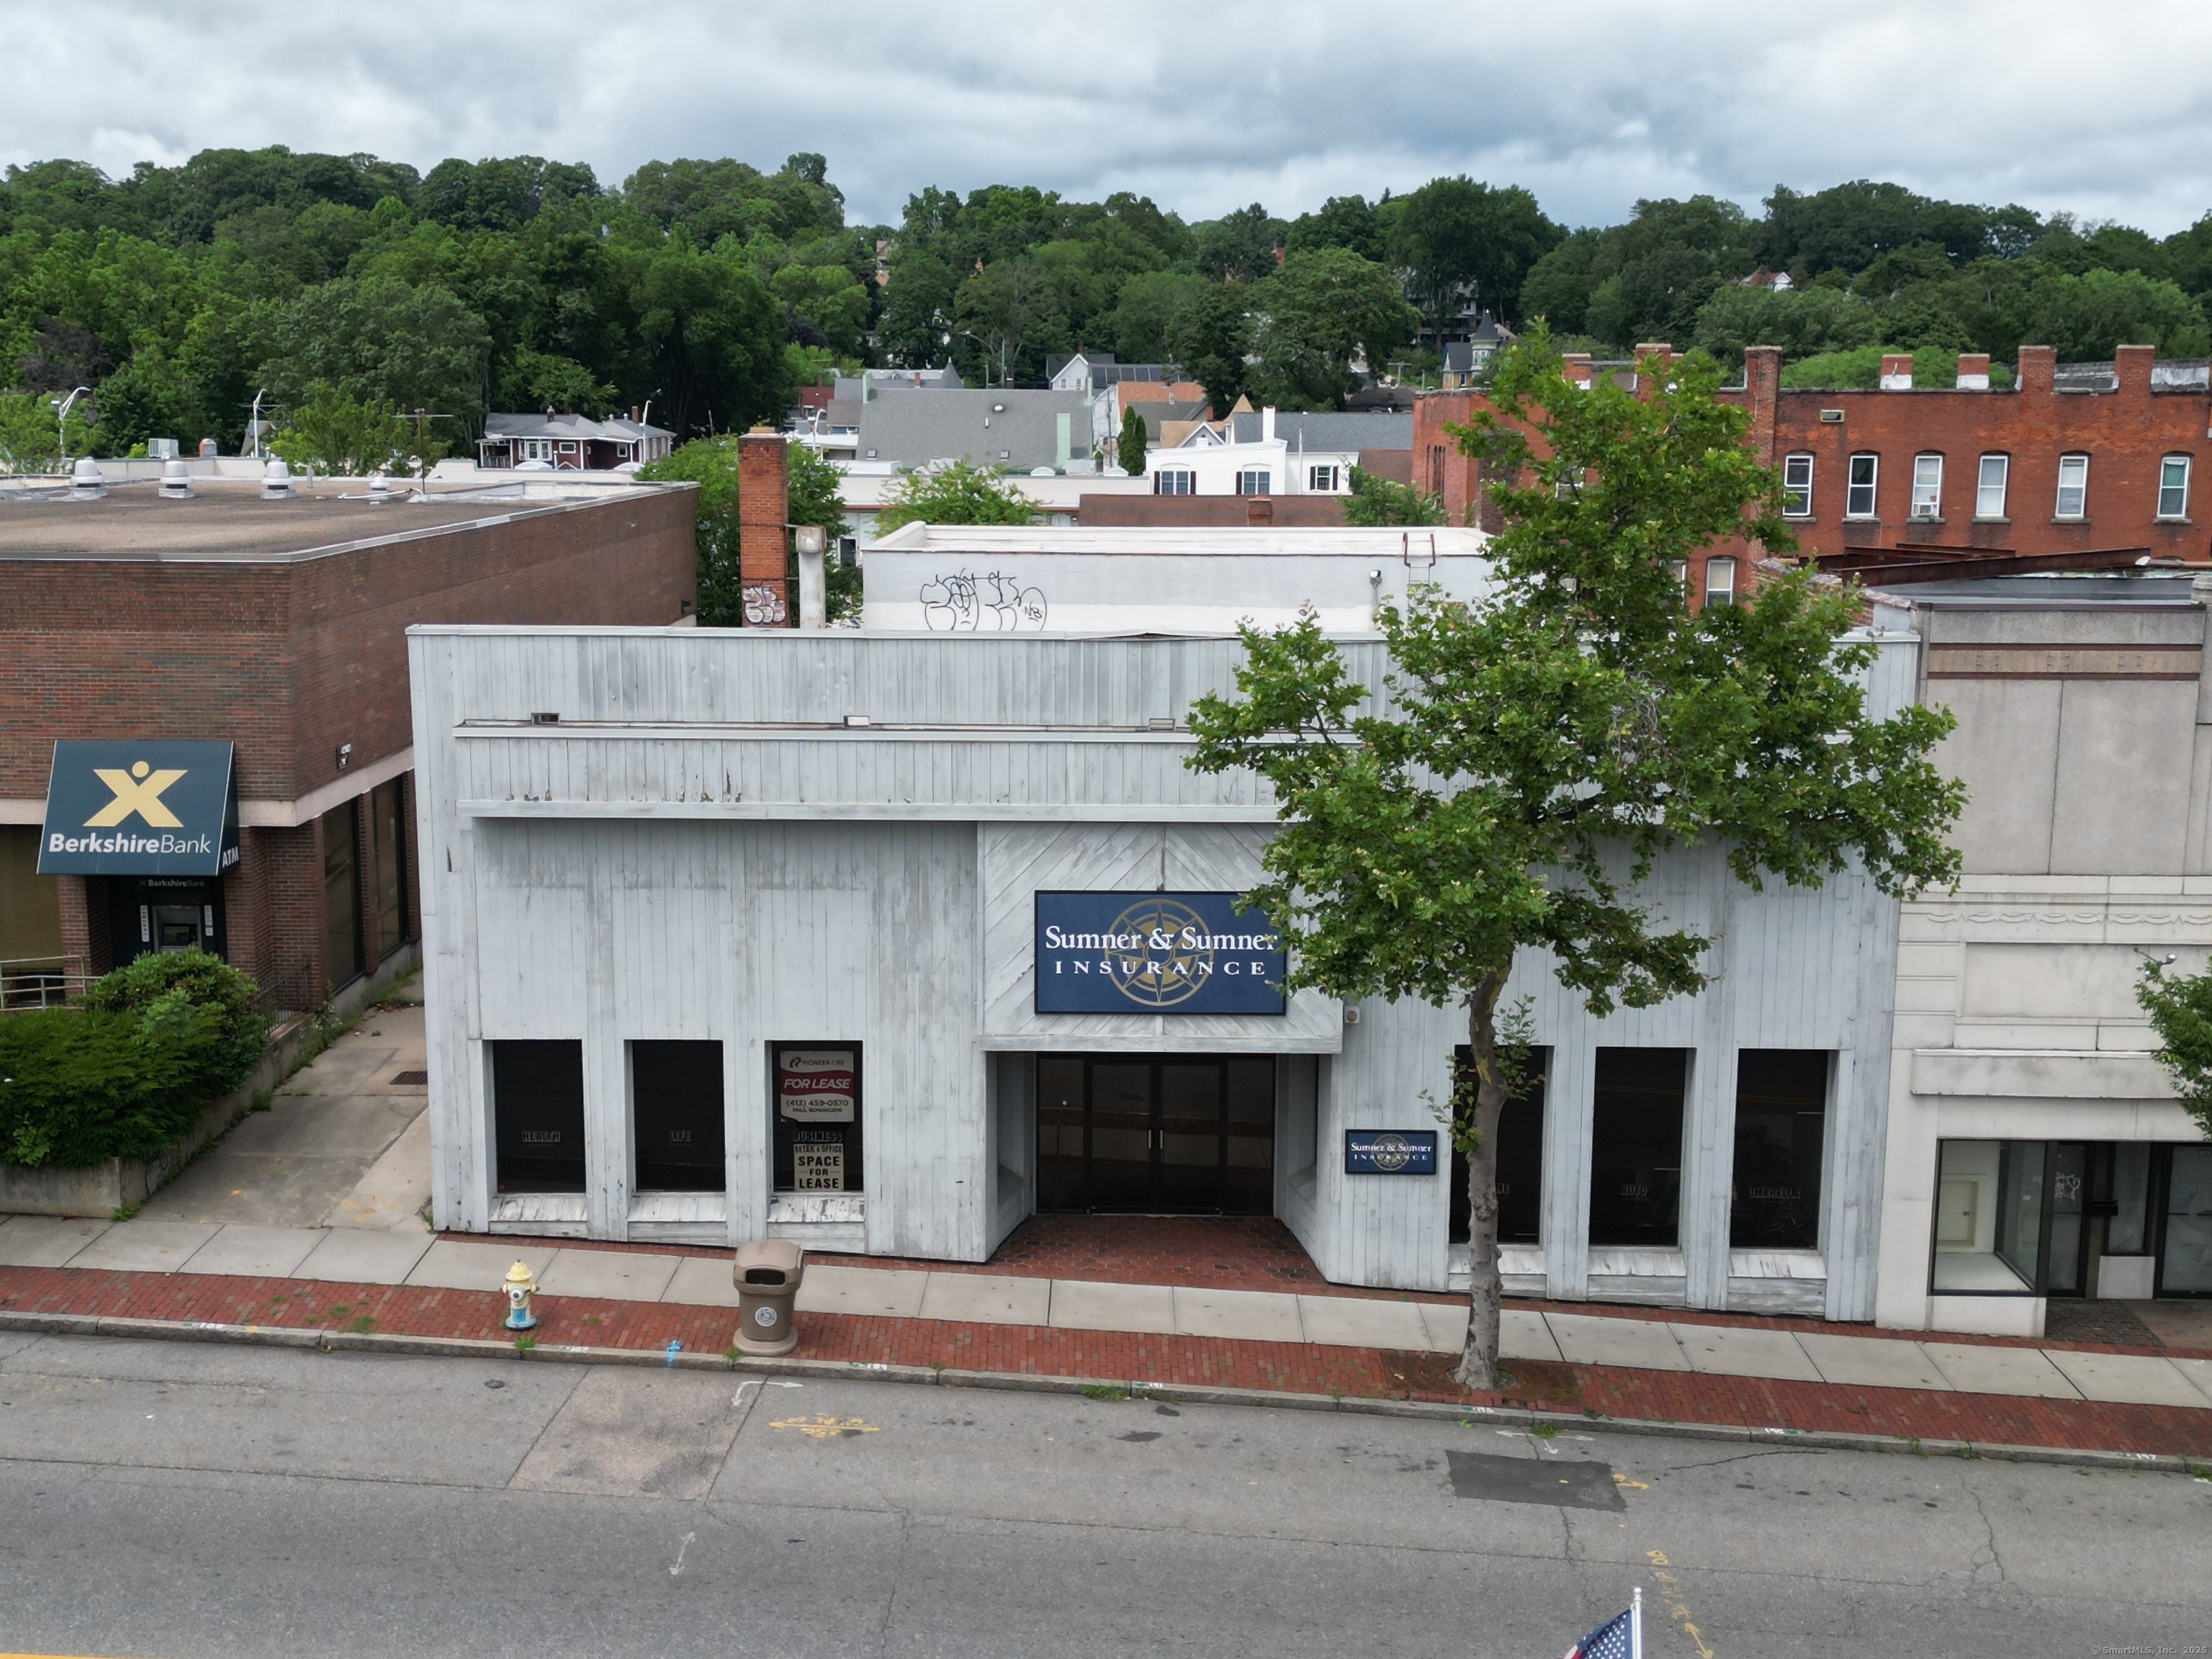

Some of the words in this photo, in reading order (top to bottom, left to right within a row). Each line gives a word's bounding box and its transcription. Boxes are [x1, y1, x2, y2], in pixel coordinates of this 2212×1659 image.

[48, 832, 212, 854] BerkshireBank
[222, 846, 239, 868] ATM
[148, 878, 206, 888] BerkshireBank
[1045, 925, 1142, 950] Sumner
[1148, 927, 1174, 950] &
[1181, 926, 1277, 951] Sumner
[1055, 961, 1266, 976] INSURANCE
[783, 1079, 811, 1089] FOR
[811, 1079, 851, 1089] LEASE
[522, 1131, 560, 1142] HEALTH
[668, 1130, 691, 1142] LIFE
[793, 1130, 843, 1142] BUSINESS
[1351, 1142, 1385, 1151] Sumner
[1398, 1143, 1431, 1152] Sumner
[798, 1156, 840, 1166] SPACE
[799, 1178, 839, 1189] LEASE
[1620, 1184, 1647, 1197] AUTO
[1748, 1187, 1801, 1199] UMBRELLA
